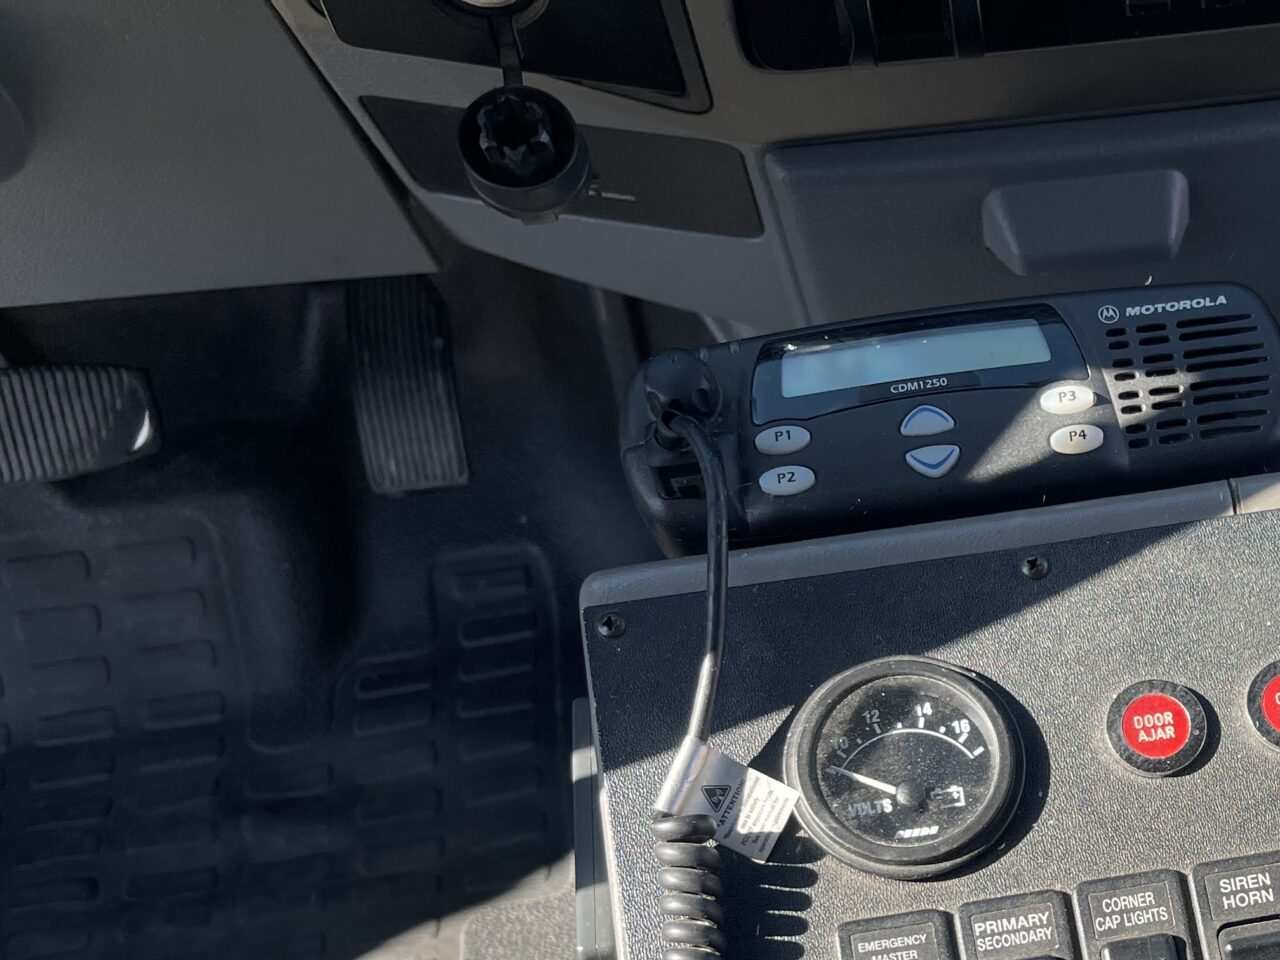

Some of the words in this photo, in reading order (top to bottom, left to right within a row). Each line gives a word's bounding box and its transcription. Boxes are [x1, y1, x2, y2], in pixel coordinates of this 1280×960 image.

[1125, 294, 1227, 316] MOTOROLA
[890, 376, 948, 394] CDM1250
[1058, 389, 1077, 404] P3
[774, 429, 793, 443] P1
[1068, 428, 1088, 442] P4
[777, 470, 797, 485] P2
[862, 709, 882, 724] 12
[914, 701, 933, 718] 14
[952, 718, 971, 735] 16
[1132, 711, 1174, 729] DOOR
[1138, 726, 1176, 742] AJAR
[847, 798, 893, 818] VOLTS
[1219, 871, 1272, 895] SIREN
[1102, 891, 1155, 914] CORNER
[1222, 886, 1275, 910] HORN
[974, 912, 1051, 938] PRIMARY
[1095, 914, 1122, 933] CAP
[1123, 907, 1169, 928] LIGHTS
[857, 933, 927, 954] EMERGENCY
[976, 926, 1053, 952] SECONDARY
